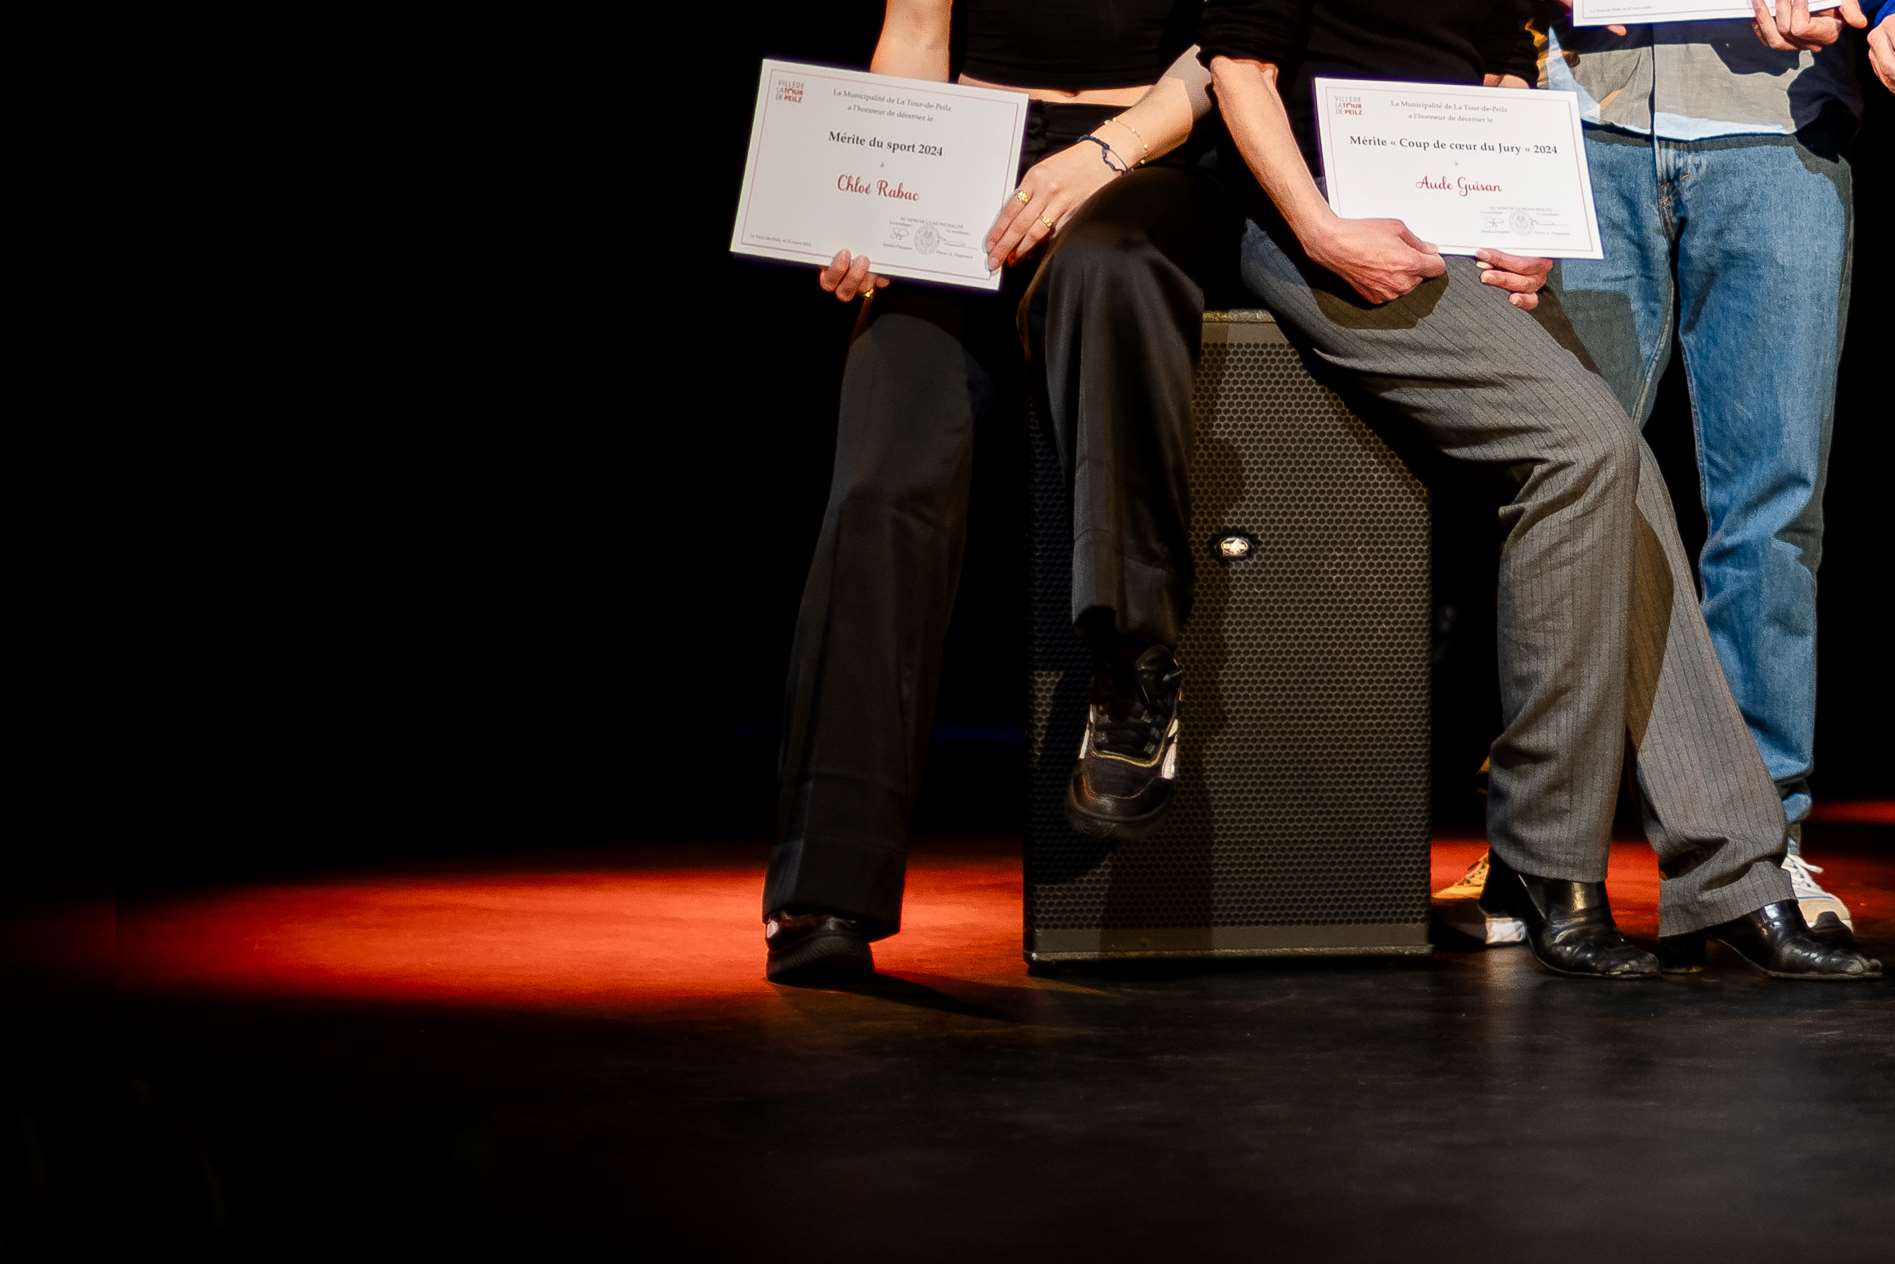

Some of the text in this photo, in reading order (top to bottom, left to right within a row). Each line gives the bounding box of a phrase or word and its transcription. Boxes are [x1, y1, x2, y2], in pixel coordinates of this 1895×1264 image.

[829, 130, 943, 156] Mérite du sport 2024
[1350, 135, 1387, 146] Mérite
[1399, 137, 1430, 151] Coup
[1433, 139, 1447, 149] de
[1449, 141, 1477, 151] cœur
[1480, 141, 1495, 152] du
[1498, 143, 1521, 156] Jury
[1534, 144, 1558, 154] 2024
[837, 174, 920, 201] Chloé Rabac
[1416, 175, 1502, 197] Aude Guisan
